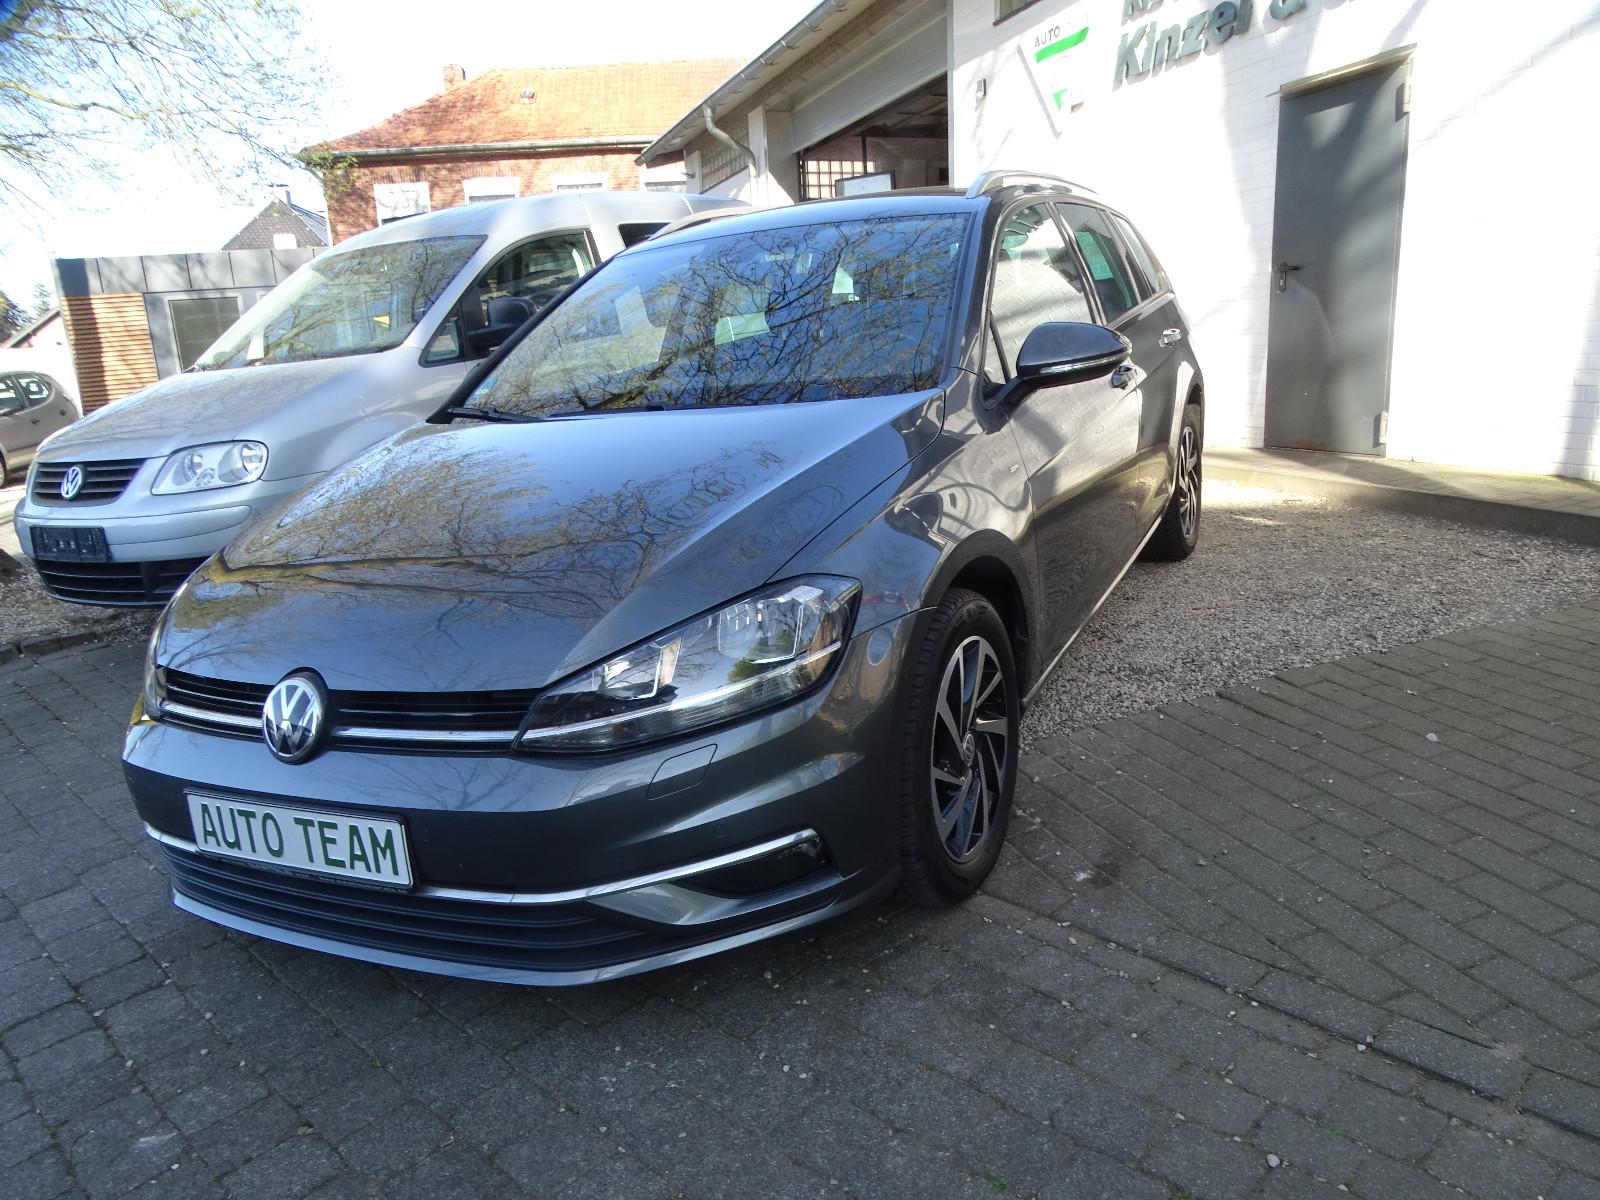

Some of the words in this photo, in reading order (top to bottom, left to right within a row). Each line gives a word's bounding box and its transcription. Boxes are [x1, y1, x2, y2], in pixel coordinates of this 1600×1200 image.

[1034, 25, 1061, 48] AUTO
[263, 677, 321, 757] VW
[200, 802, 284, 859] AUTO
[293, 815, 400, 876] TEAM
